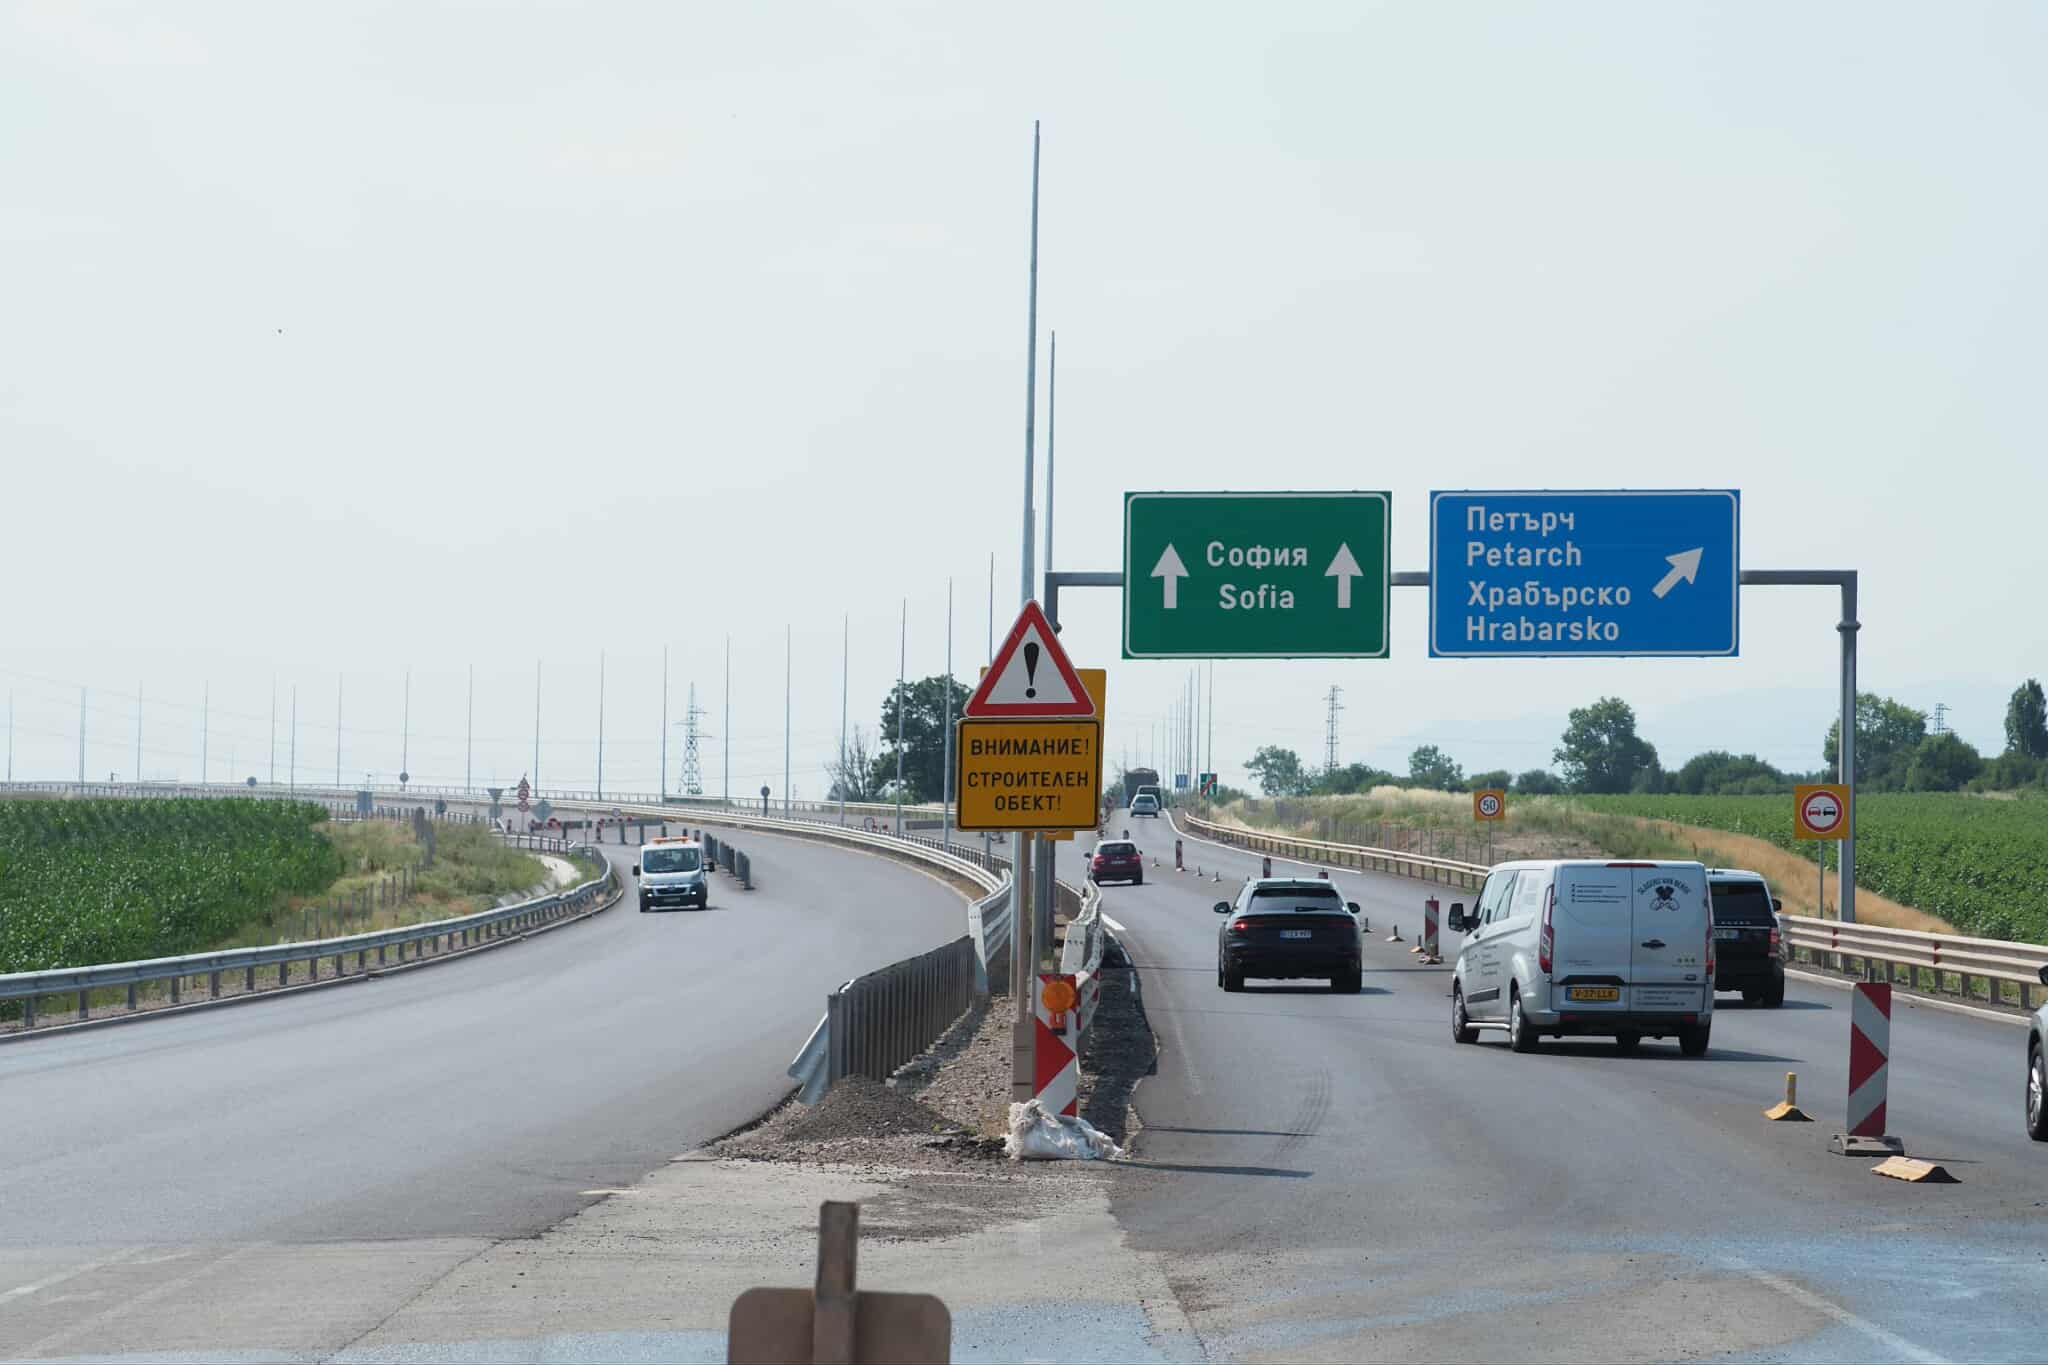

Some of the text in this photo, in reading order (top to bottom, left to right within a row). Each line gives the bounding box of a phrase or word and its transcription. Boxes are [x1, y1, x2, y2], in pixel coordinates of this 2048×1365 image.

[1468, 507, 1575, 536] Петърч
[1206, 541, 1307, 569] София
[1467, 541, 1582, 567] Petarch
[1219, 584, 1295, 610] Sofia
[1467, 581, 1631, 611] Храбърско
[1467, 616, 1619, 641] Hrabarsko
[970, 739, 1089, 755] ВНИМАНИЕ!
[968, 772, 1089, 787] СТРОИТЕЛЕН
[994, 795, 1061, 811] ОБЕКТ!
[1483, 799, 1496, 811] 50
